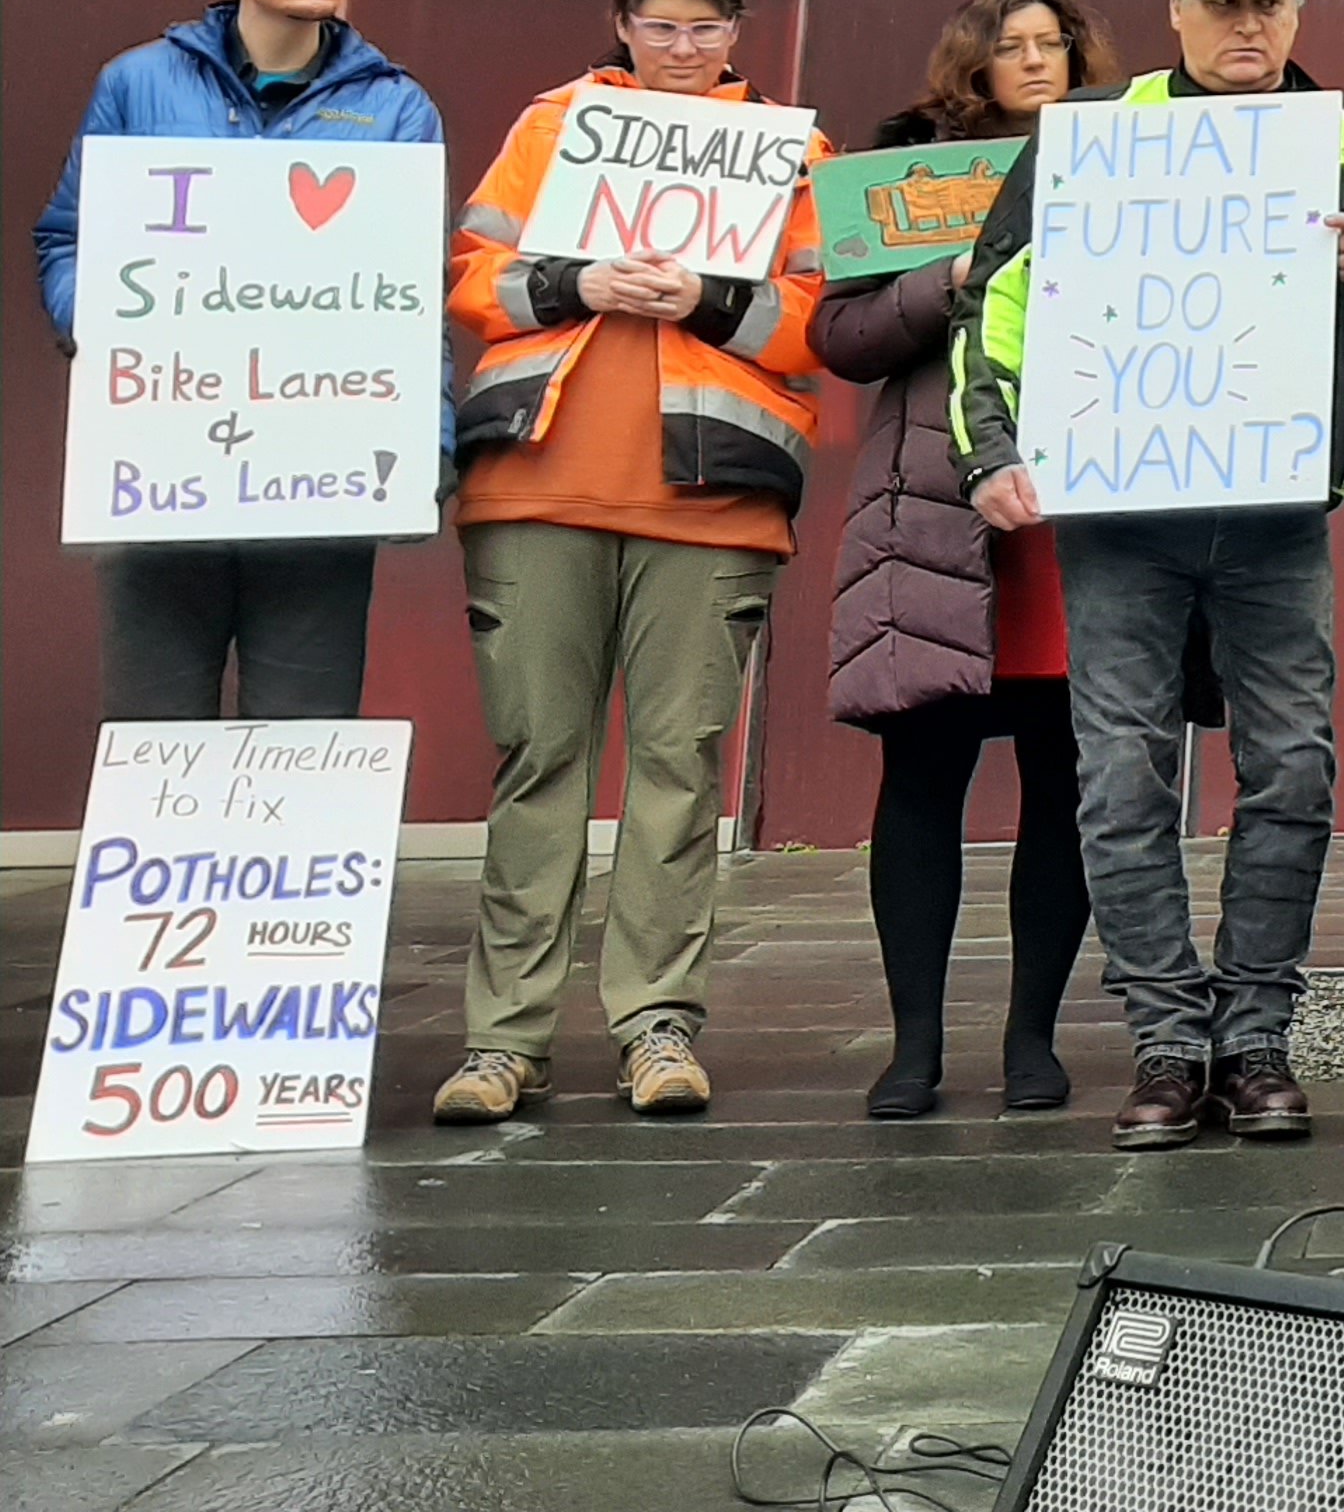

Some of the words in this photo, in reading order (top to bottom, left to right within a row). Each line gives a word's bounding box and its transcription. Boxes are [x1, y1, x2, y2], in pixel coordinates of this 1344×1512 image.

[559, 104, 806, 187] SIDEWALKS
[1069, 103, 1283, 178] WHAT
[145, 166, 211, 234] I
[576, 174, 786, 264] NOW
[1040, 190, 1298, 260] FUTURE
[114, 258, 427, 319] Sidewalks,
[1136, 271, 1222, 333] DO
[109, 348, 223, 405] Bike
[248, 348, 403, 402] Lanes,
[1103, 341, 1225, 415] YOU
[111, 461, 207, 518] Bus
[238, 450, 399, 504] Lanes!
[1064, 412, 1324, 493] WANT?
[102, 730, 206, 778] Levy
[224, 723, 393, 774] Timeline
[150, 779, 199, 819] to
[219, 774, 287, 825] fix
[80, 836, 383, 909] POTHOLES:
[123, 907, 218, 972] 72
[247, 919, 352, 948] HOURS
[49, 981, 378, 1054] SIDEWALKS
[82, 1061, 240, 1137] 500
[257, 1073, 365, 1109] YEARS
[1094, 1356, 1157, 1384] Roland
